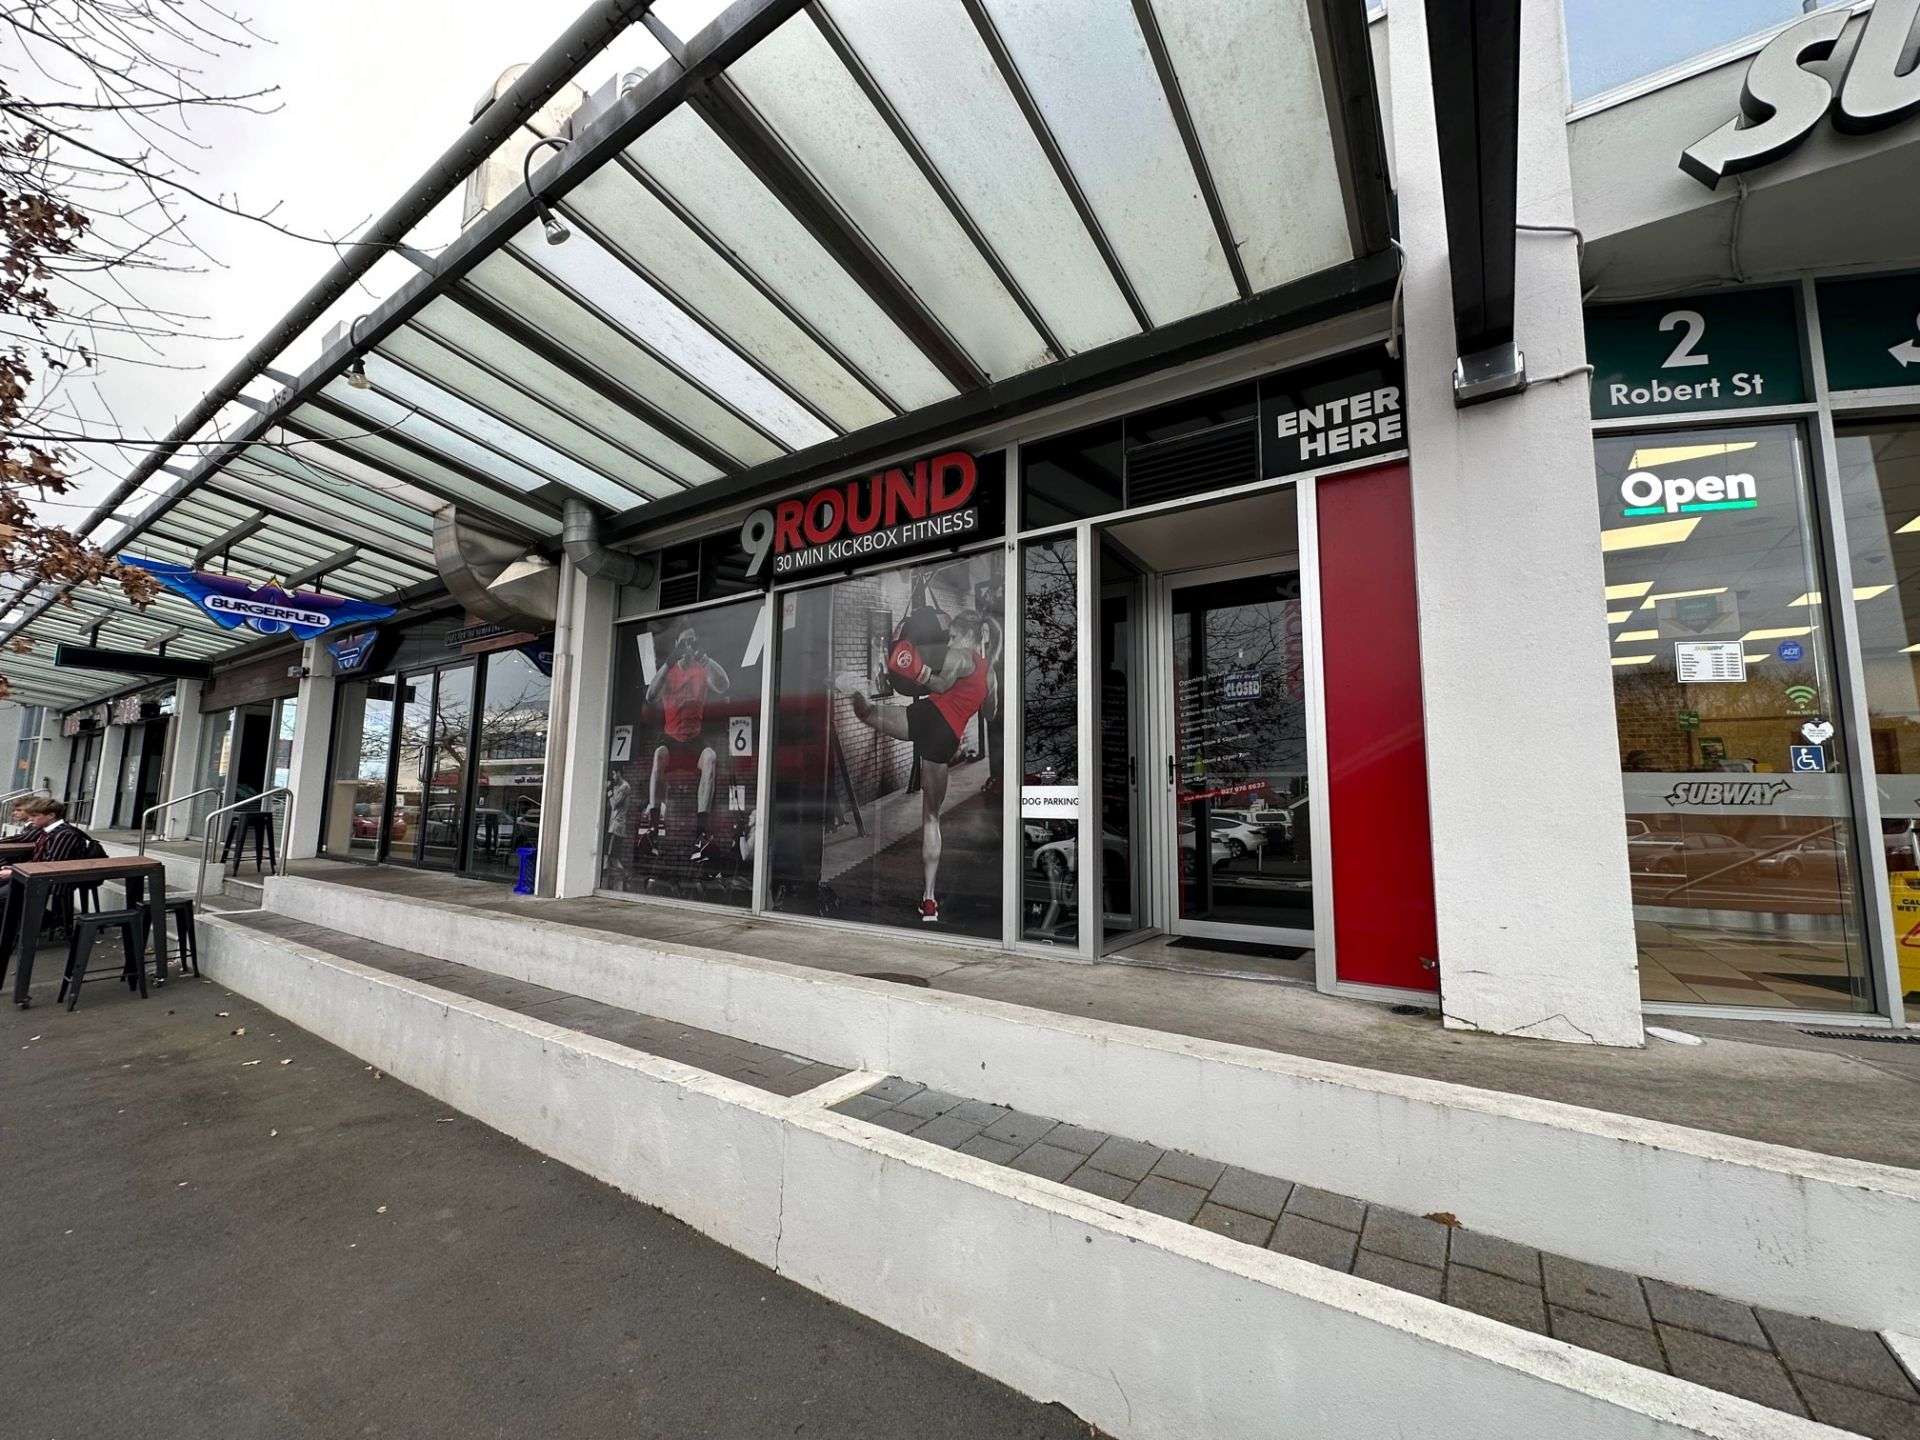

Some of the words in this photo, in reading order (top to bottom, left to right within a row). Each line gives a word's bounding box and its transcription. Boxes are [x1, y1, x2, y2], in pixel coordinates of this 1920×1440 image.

[1659, 310, 1709, 369] 2
[1609, 378, 1721, 406] Robert
[1732, 373, 1764, 397] St
[1277, 386, 1400, 438] ENTER
[1300, 413, 1402, 461] HERE
[1621, 471, 1757, 513] Open
[741, 451, 978, 578] 9ROUND
[776, 554, 792, 574] 30
[795, 548, 824, 570] MIN
[827, 530, 898, 560] KICKBOX
[902, 509, 975, 544] FITNESS
[211, 597, 327, 626] BURGERFUEL
[1782, 648, 1801, 657] ADT
[1225, 680, 1260, 697] CLOSED
[616, 736, 627, 757] 7
[734, 729, 747, 751] 6
[1022, 797, 1041, 806] DOG
[1043, 797, 1079, 806] PARKING
[1664, 780, 1792, 806] SUBWAY
[1896, 904, 1918, 912] WET
